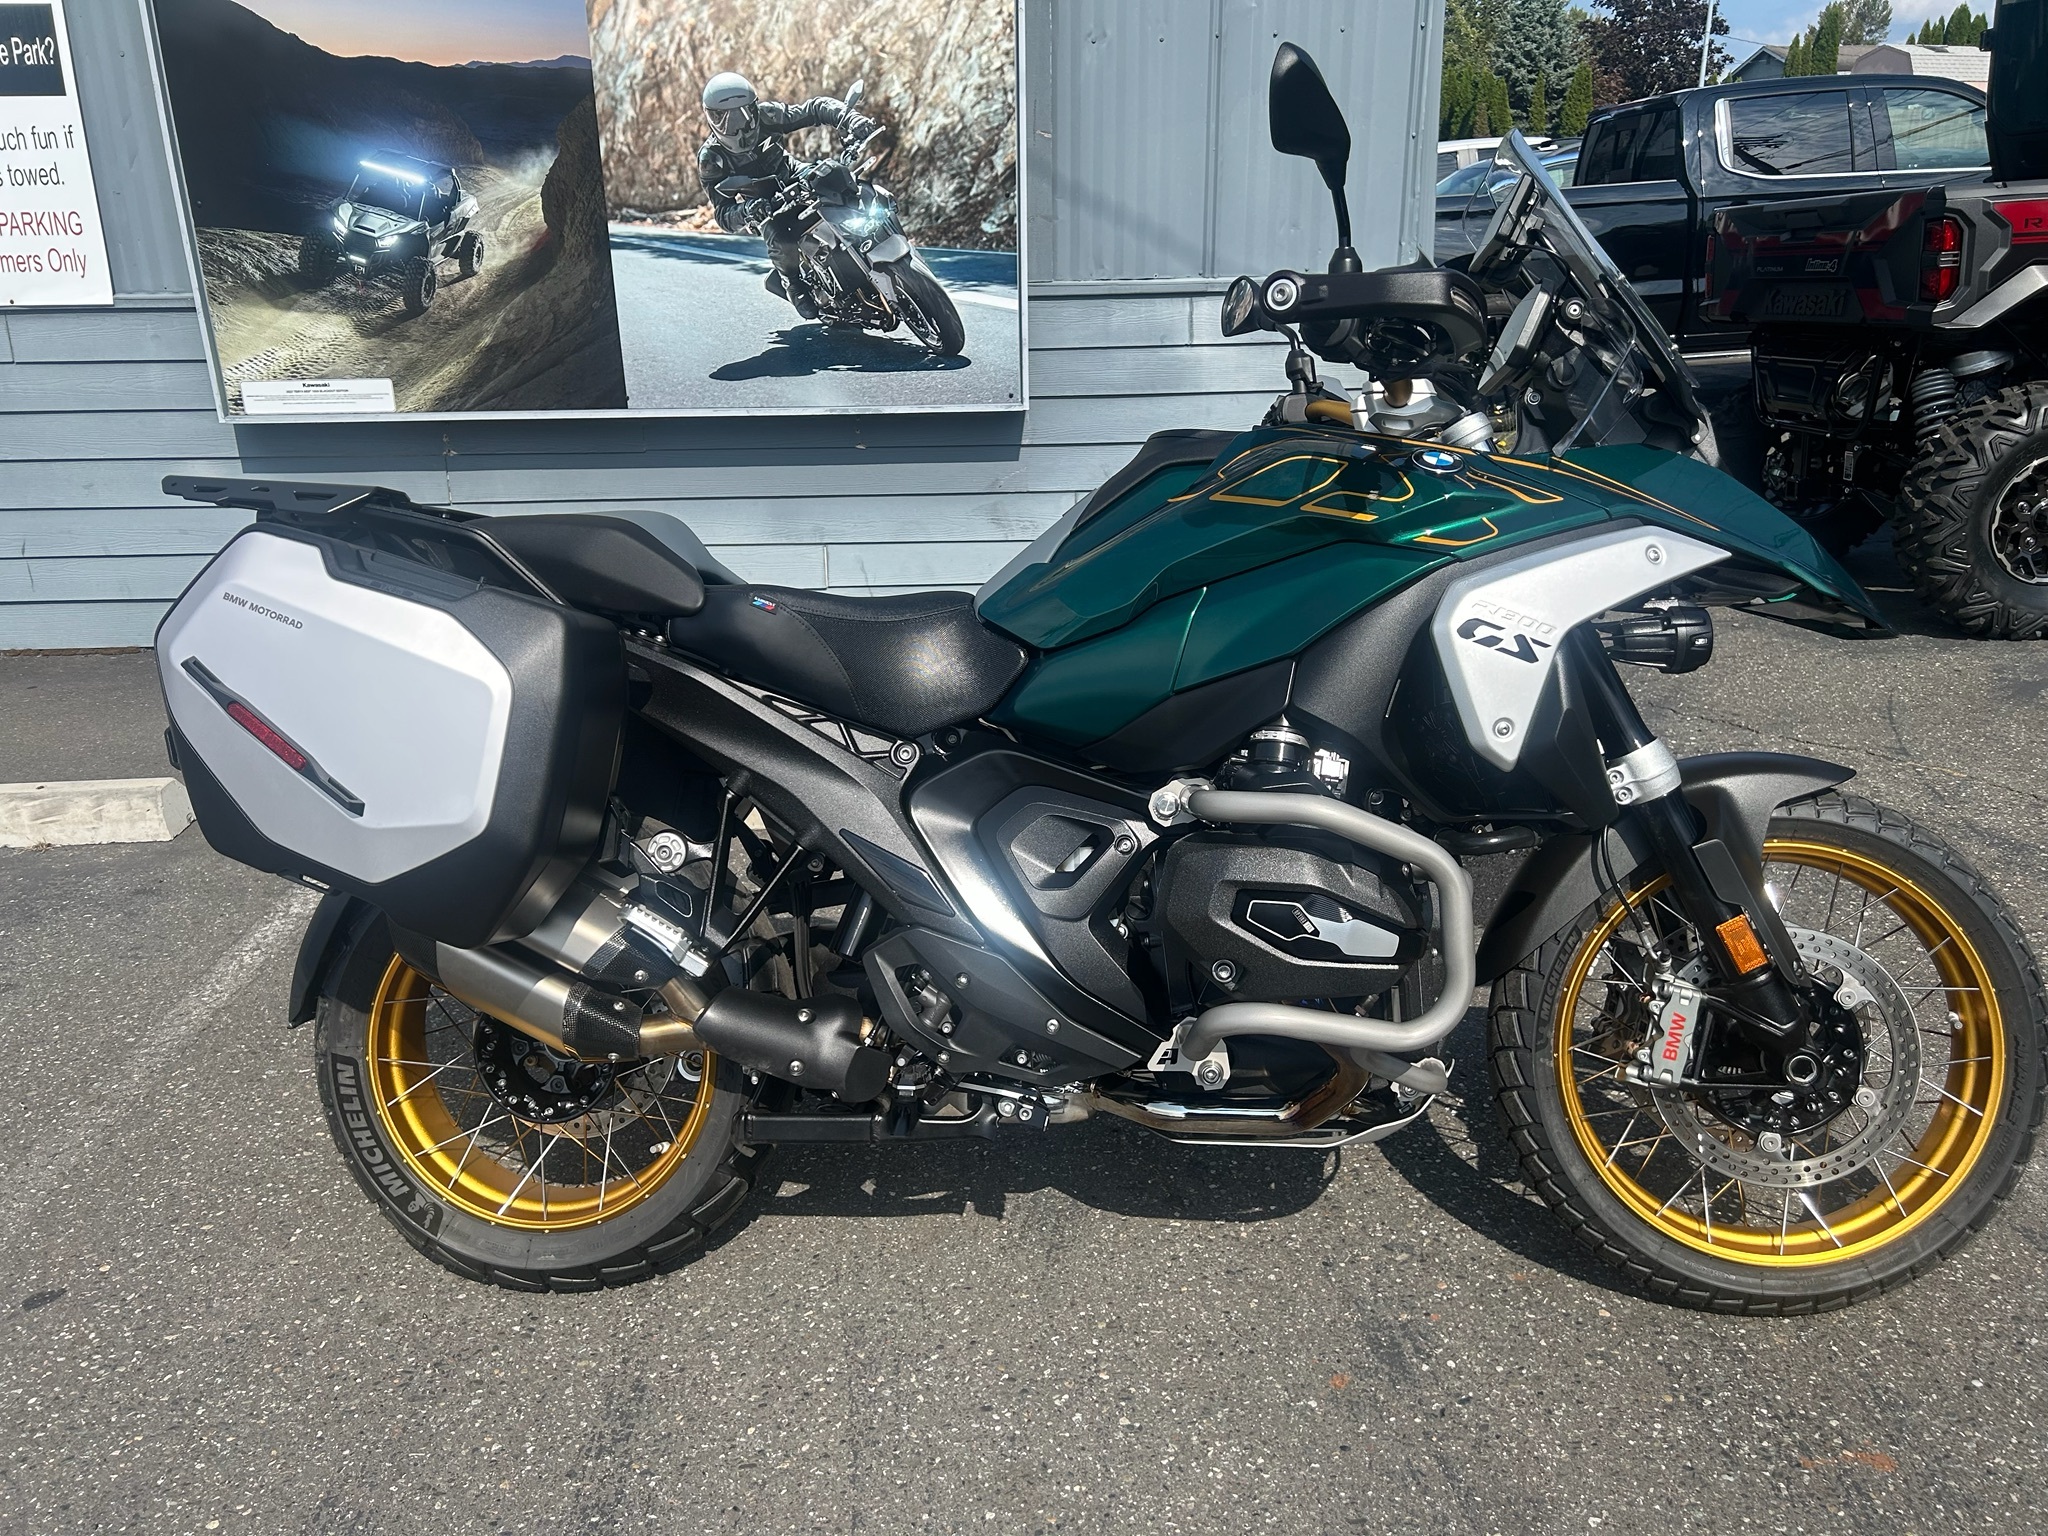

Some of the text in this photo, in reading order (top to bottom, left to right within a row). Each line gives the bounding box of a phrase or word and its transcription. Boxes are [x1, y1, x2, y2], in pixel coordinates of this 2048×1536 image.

[10, 36, 55, 65] Park?
[31, 125, 59, 150] fun
[62, 124, 75, 149] if
[7, 161, 65, 187] towed.
[0, 211, 83, 236] PARKING
[48, 247, 87, 279] Only
[1764, 288, 1848, 316] Kawasaki
[222, 591, 304, 630] BMW MOTORRAD
[1457, 617, 1552, 664] GS
[1540, 929, 1579, 1022] MICHELIN
[1662, 1011, 1687, 1062] BMW
[335, 1062, 410, 1198] MICHELIN
